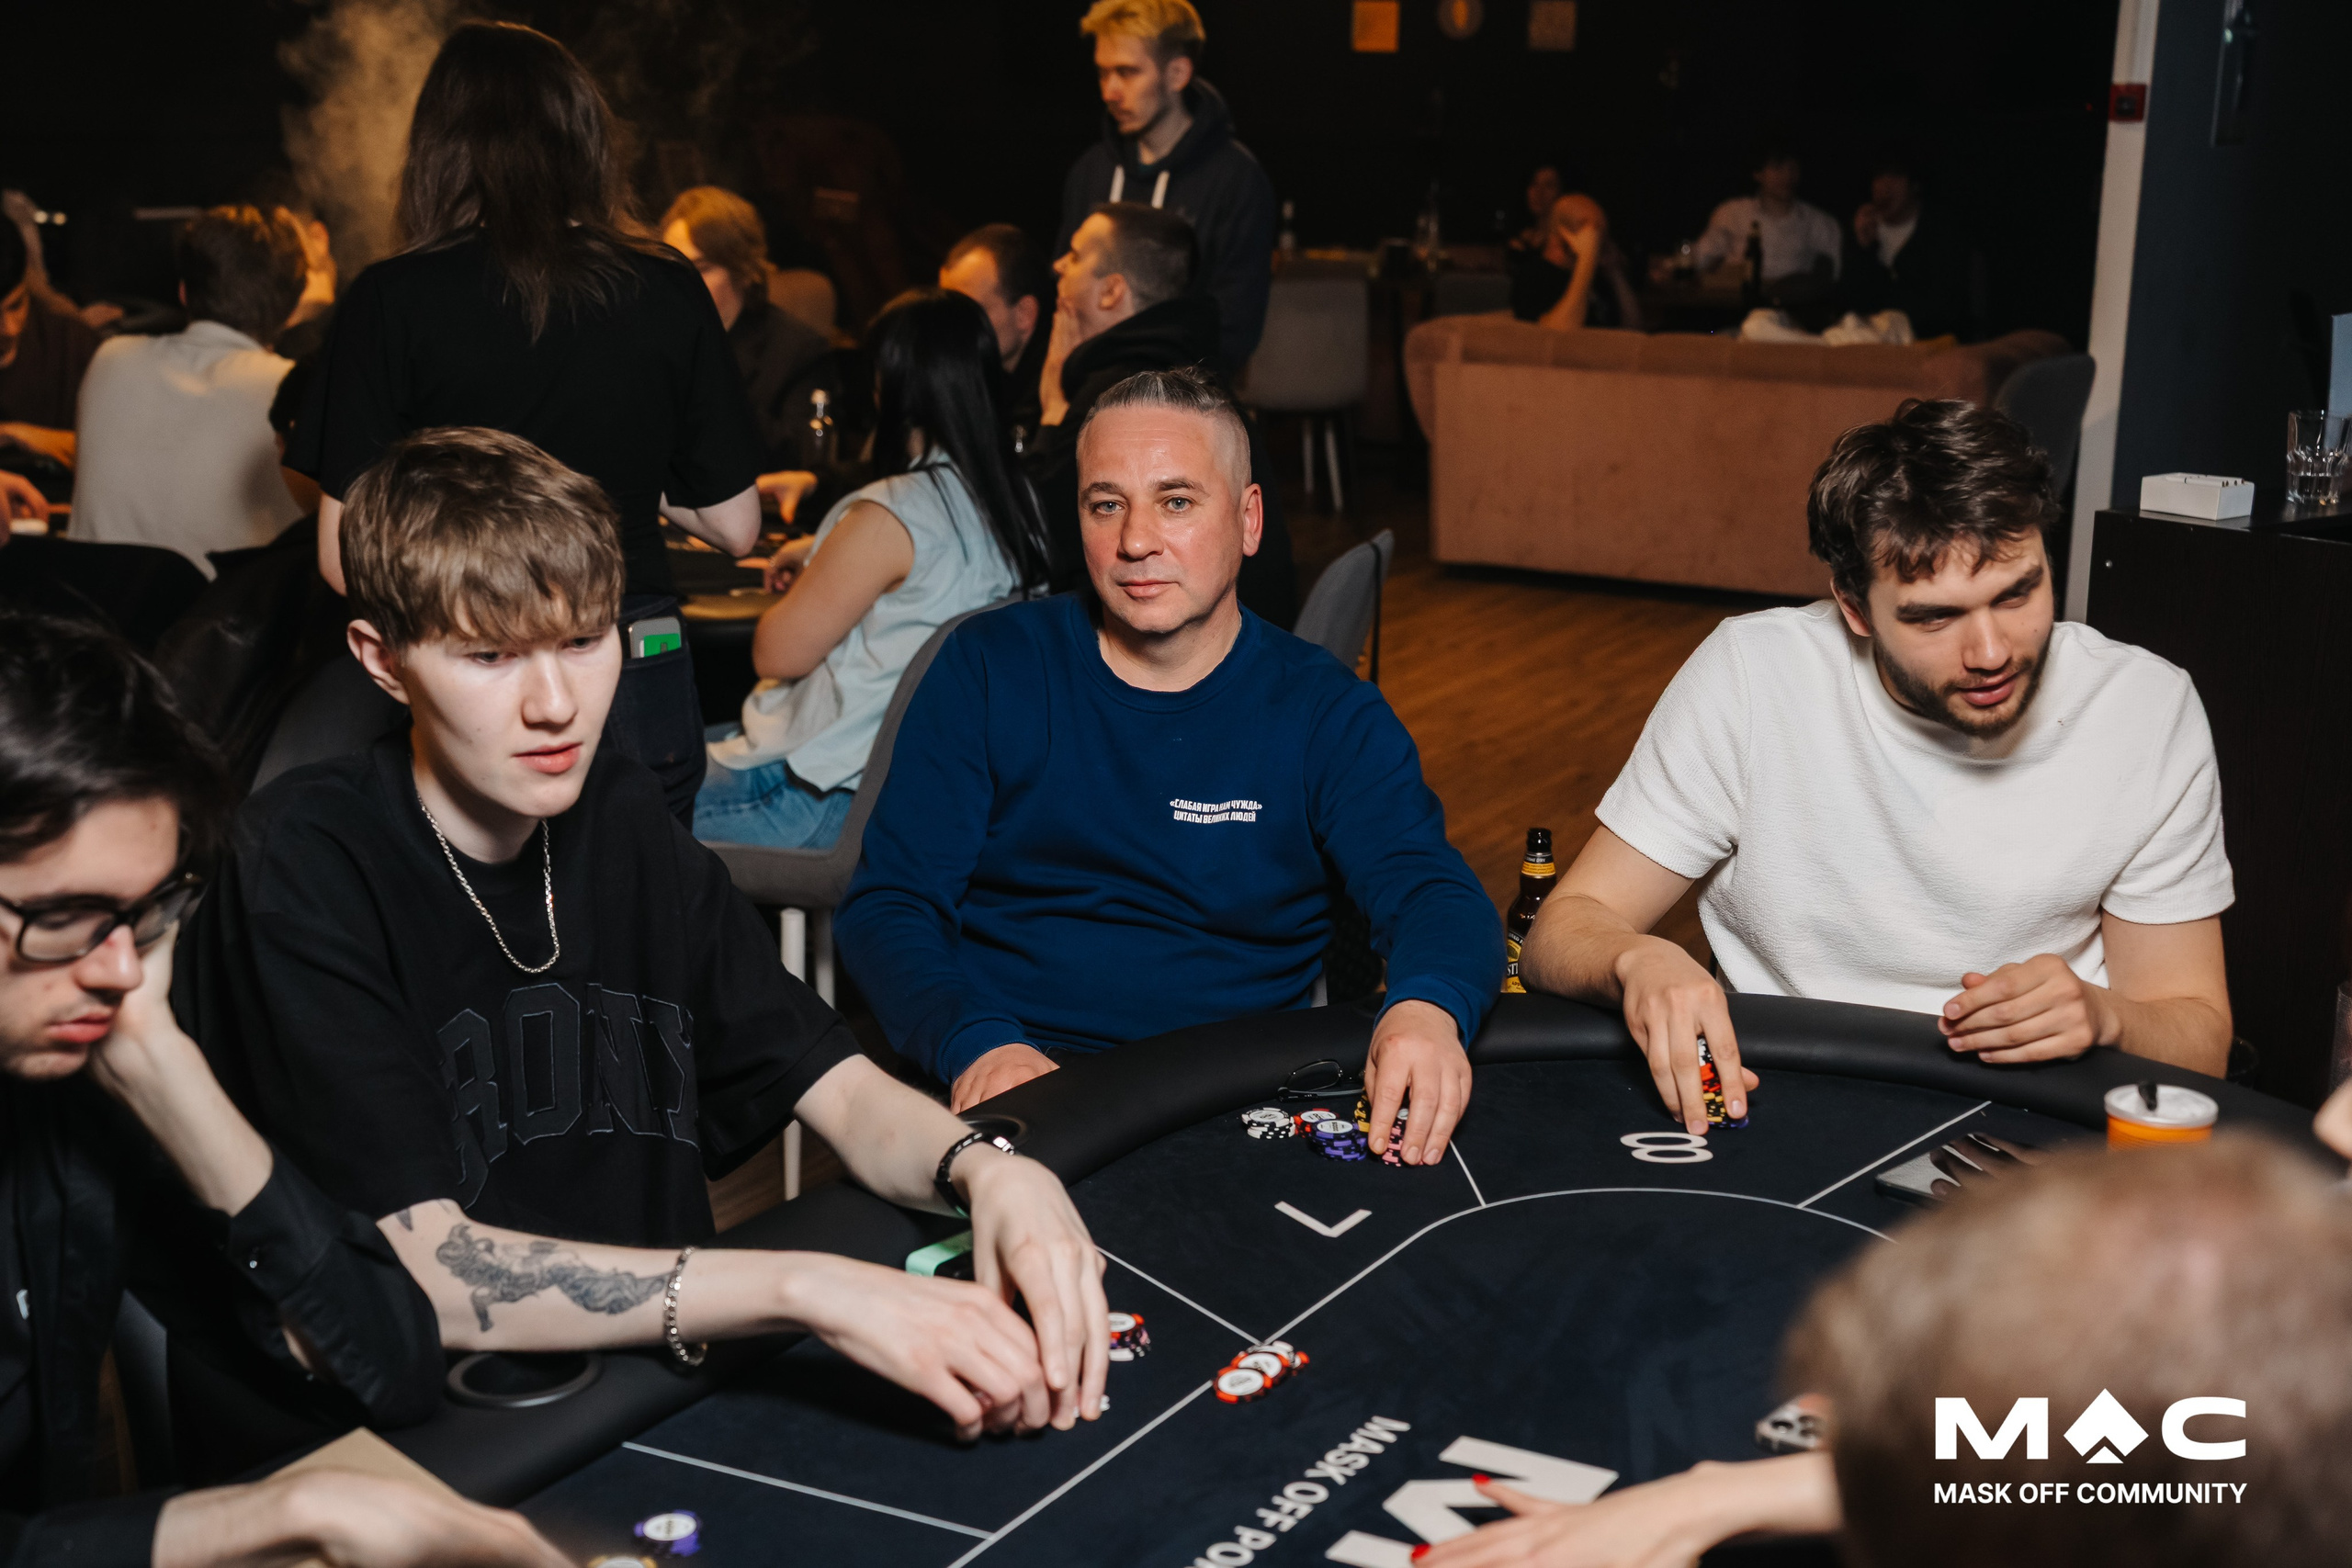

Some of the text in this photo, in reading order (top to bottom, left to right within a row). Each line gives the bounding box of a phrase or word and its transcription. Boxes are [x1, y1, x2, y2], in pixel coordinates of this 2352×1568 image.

[1173, 810, 1256, 824] ЦИТАТЫ ВЕЛИКИХ ЛЮДЕЙ
[1203, 803, 1219, 813] ИГРА
[1620, 1131, 1713, 1164] 8
[1305, 1416, 1411, 1485] MASK
[1256, 1481, 1329, 1531] OFF
